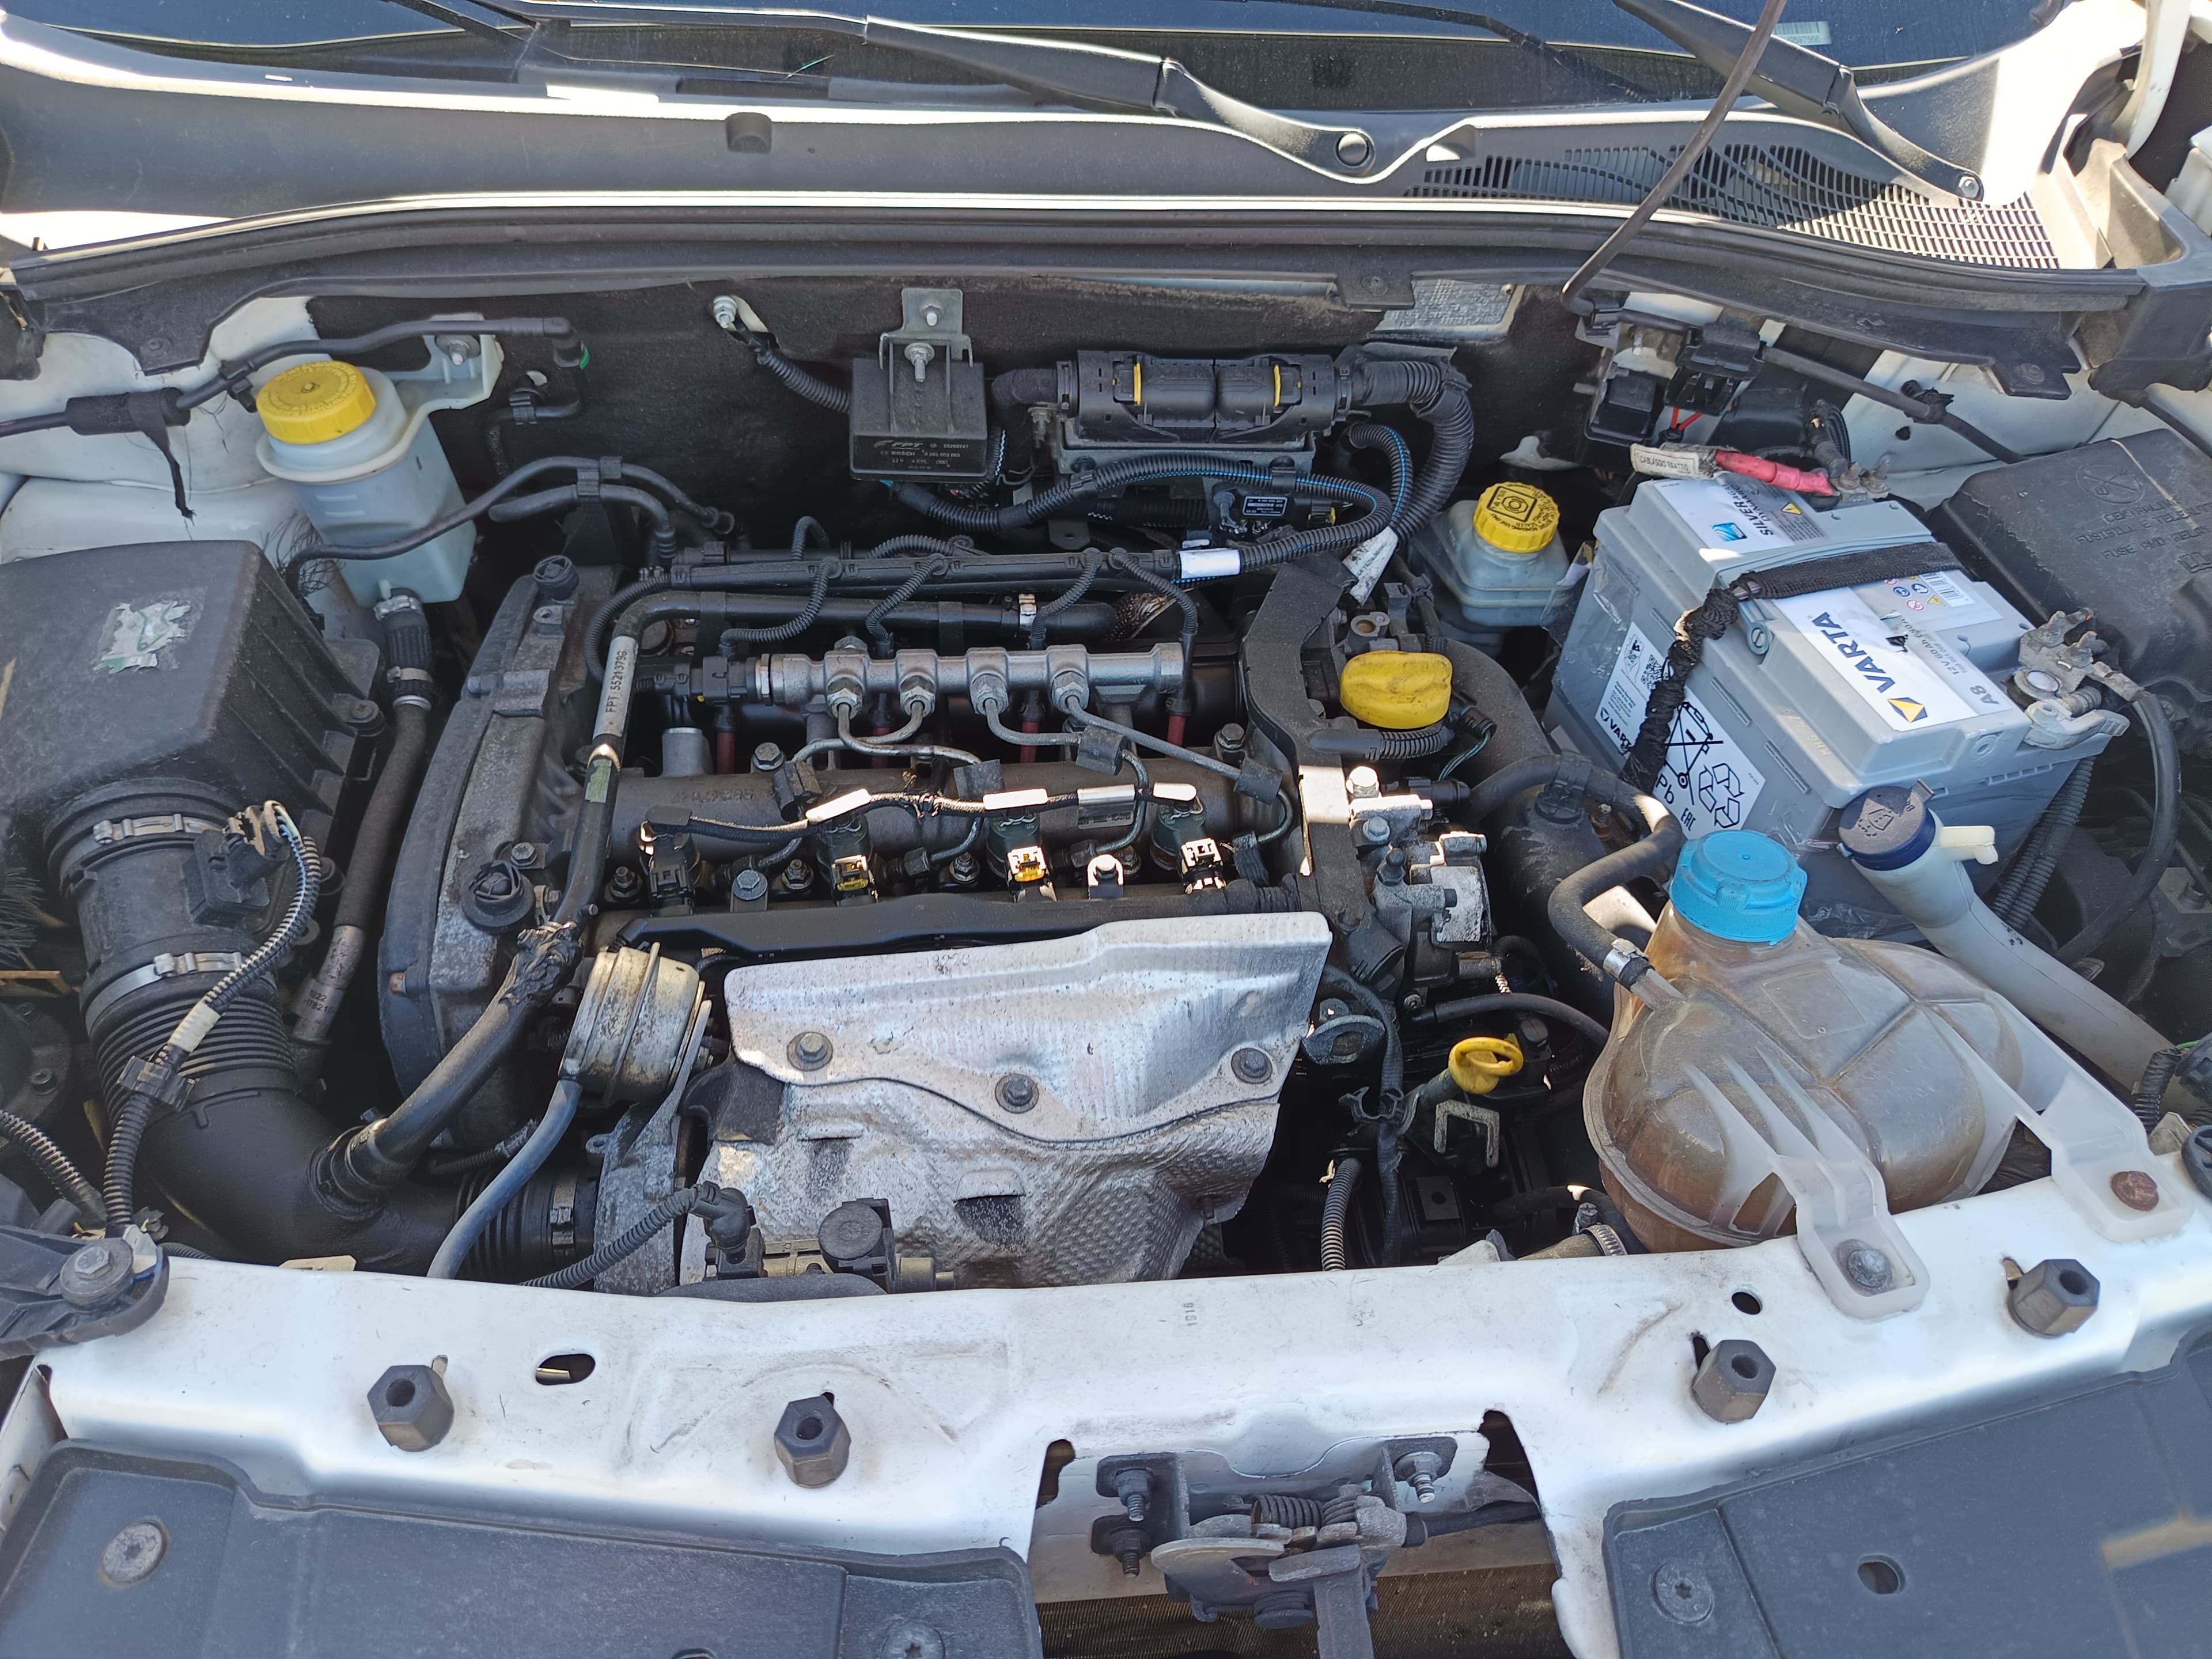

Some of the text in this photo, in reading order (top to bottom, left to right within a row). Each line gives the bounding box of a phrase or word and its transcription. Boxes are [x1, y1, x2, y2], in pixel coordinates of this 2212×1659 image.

[1730, 484, 1771, 522] DYNAMIC
[1733, 501, 1774, 536] SILVER
[2102, 545, 2138, 560] FUSE
[2140, 537, 2166, 550] AND
[1810, 611, 1896, 694] VARTA
[1922, 639, 1943, 659] 60Ah
[1941, 660, 1960, 675] 12V
[605, 695, 619, 713] FPT
[1969, 685, 2000, 705] A8
[1610, 718, 1632, 748] VART
[1655, 774, 1675, 805] Pb
